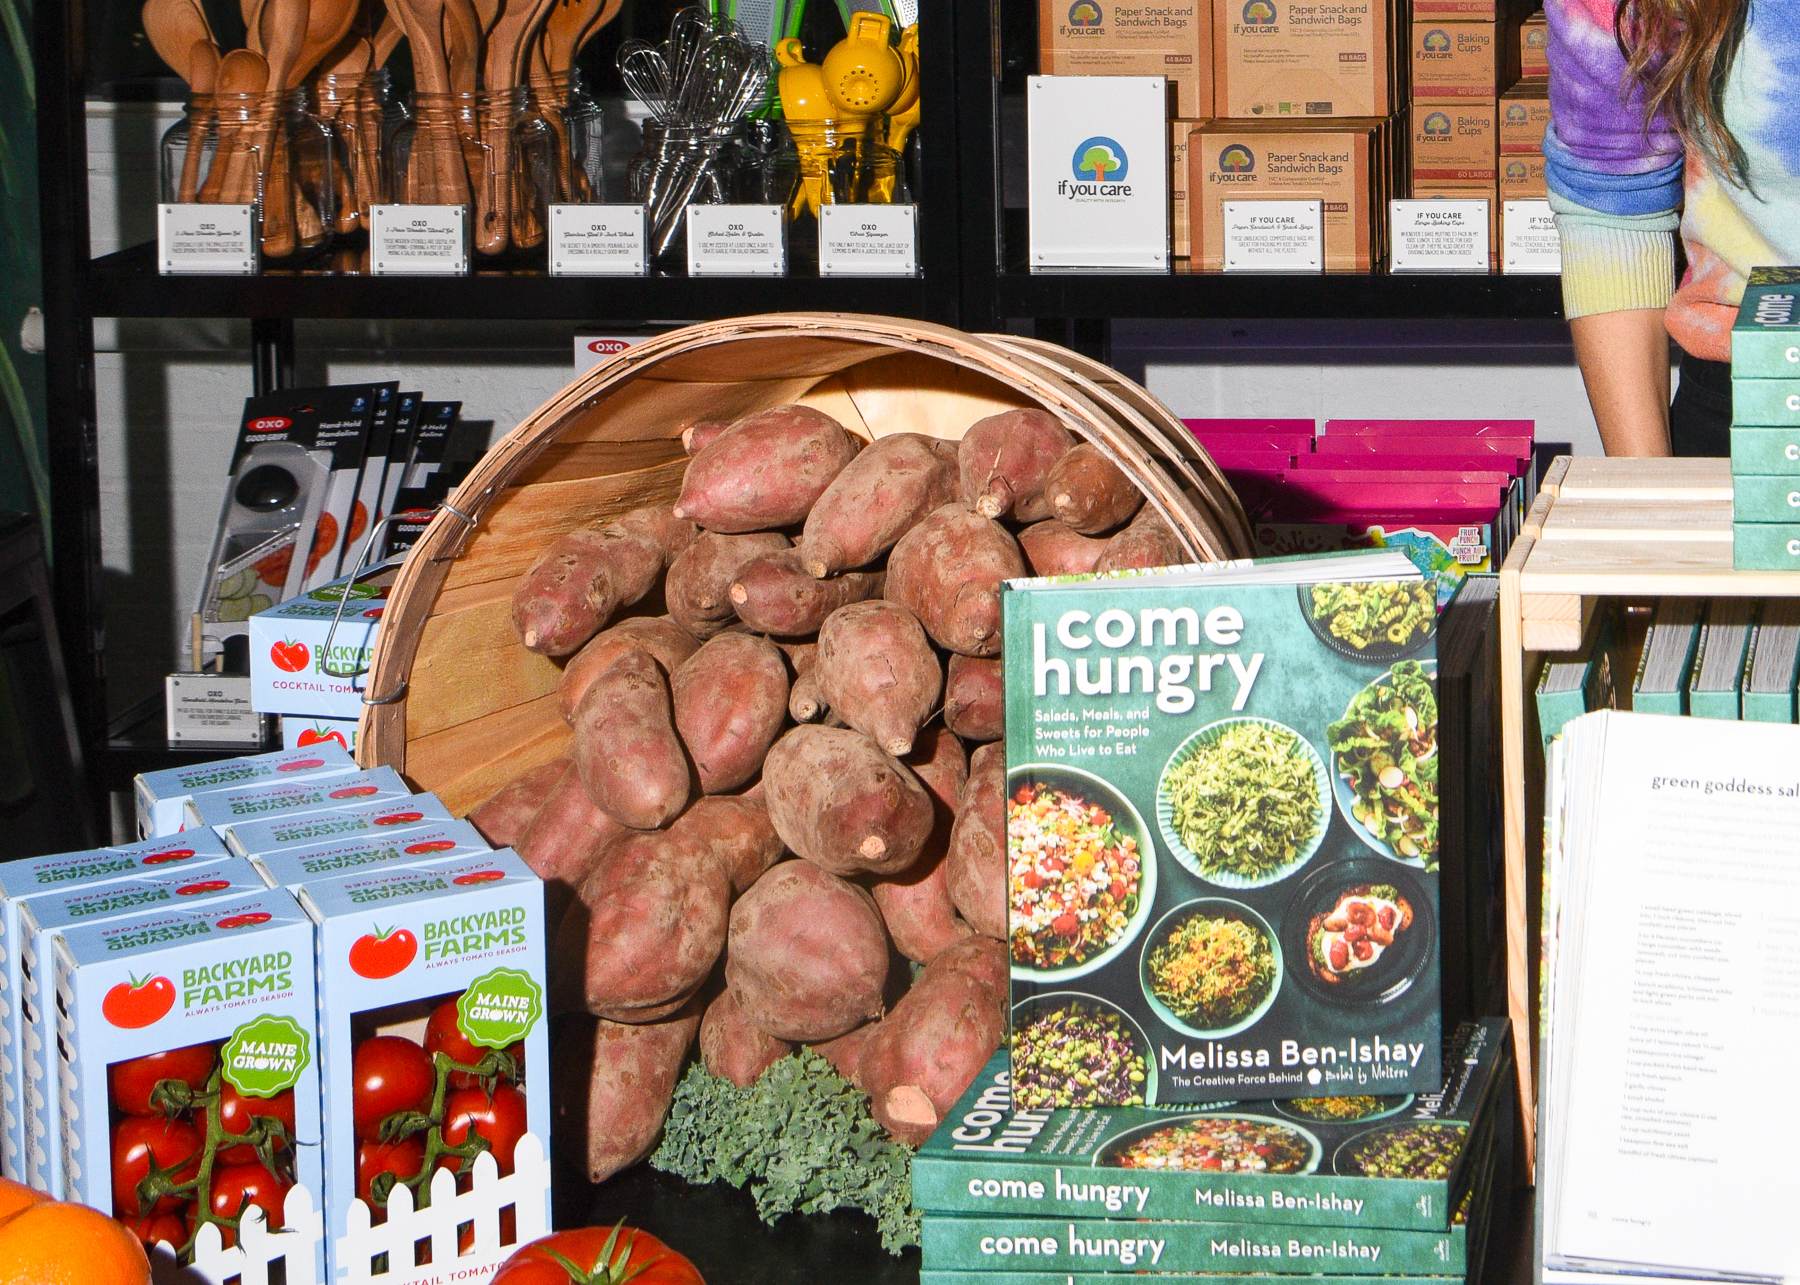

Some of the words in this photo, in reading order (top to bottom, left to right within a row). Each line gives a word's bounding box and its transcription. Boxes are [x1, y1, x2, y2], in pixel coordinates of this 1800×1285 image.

[1115, 7, 1142, 18] Paper
[1144, 6, 1173, 16] Snack
[1174, 6, 1192, 16] and
[1114, 17, 1160, 27] Sandwich
[1163, 17, 1187, 29] Bags
[1058, 180, 1067, 196] if
[1069, 183, 1097, 201] you
[1099, 183, 1131, 196] care
[595, 342, 624, 353] OXO
[255, 419, 285, 429] OXO
[319, 420, 362, 429] Hand-Held
[317, 429, 360, 438] Mandoline
[1056, 604, 1245, 650] come
[1033, 622, 1265, 713] hungry
[272, 680, 325, 693] COCKTAIL
[1035, 709, 1079, 723] Salads,
[1082, 708, 1122, 722] Meals,
[1126, 707, 1150, 720] and
[1035, 727, 1080, 741] Sweets
[1083, 725, 1102, 739] for
[1106, 725, 1150, 740] People
[1036, 744, 1065, 756] Who
[1068, 743, 1095, 756] Live
[1098, 744, 1111, 755] to
[1114, 742, 1137, 755] Eat
[1651, 774, 1700, 791] green
[1704, 777, 1773, 797] goddess
[423, 906, 526, 942] BACKYARD
[424, 928, 526, 961] FARMS
[425, 960, 455, 970] ALWAYS
[457, 952, 493, 966] TOMATO
[496, 946, 528, 959] SEASON
[182, 950, 293, 987] BACKYARD
[182, 974, 293, 1007] FARMS
[475, 993, 530, 1011] MAINE
[469, 1007, 530, 1026] GROWN
[239, 1041, 298, 1059] MAINE
[1160, 1040, 1270, 1071] Melissa
[1282, 1036, 1425, 1069] Ben-Ishay
[232, 1055, 297, 1073] GROWN
[1172, 1074, 1190, 1087] The
[1193, 1073, 1234, 1086] Creative
[1237, 1072, 1266, 1085] Force
[1269, 1071, 1303, 1084] Behind
[968, 1177, 1045, 1199] come
[1055, 1168, 1150, 1209] hungry
[1195, 1189, 1265, 1209] Melissa
[1271, 1190, 1364, 1214] Ben-Ishay
